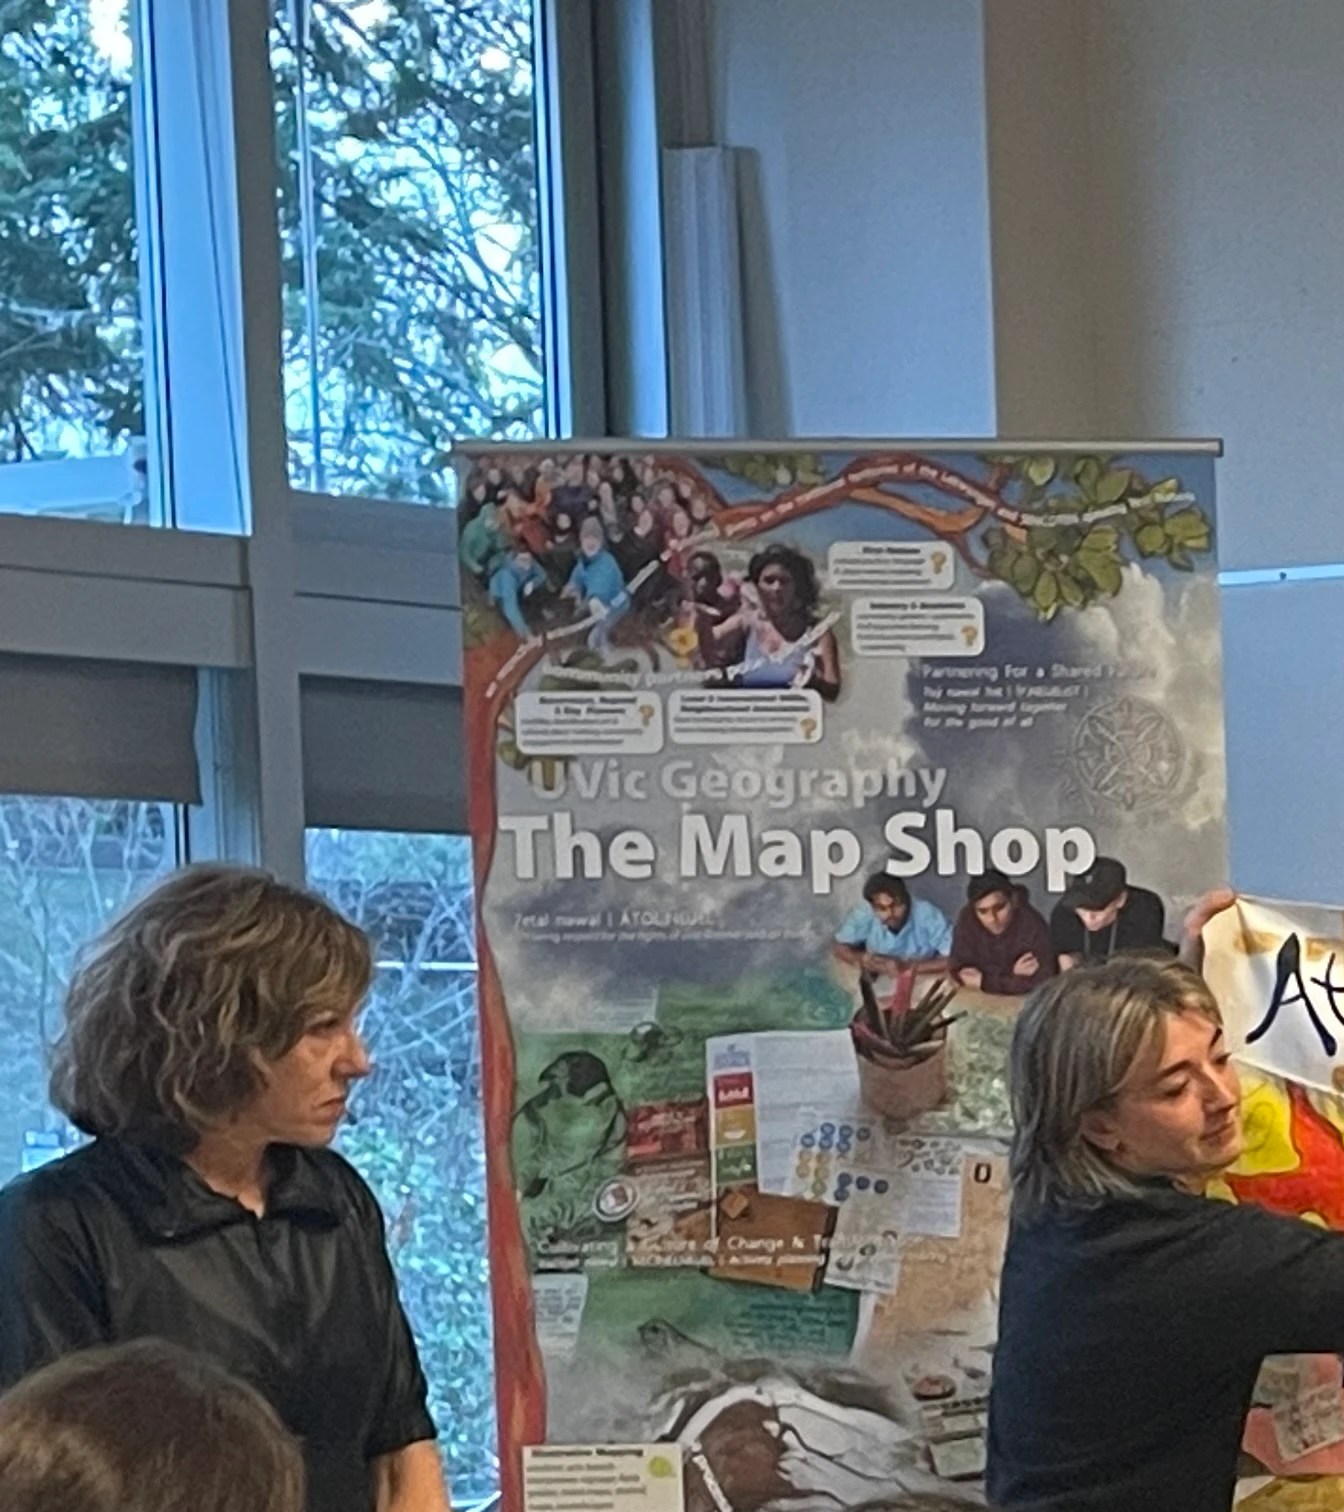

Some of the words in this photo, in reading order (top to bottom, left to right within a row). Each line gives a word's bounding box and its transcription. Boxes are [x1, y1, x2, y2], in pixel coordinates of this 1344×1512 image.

[528, 758, 647, 801] UVic
[661, 757, 948, 809] Geography
[499, 812, 656, 880] The
[680, 813, 862, 894] Map
[884, 809, 1096, 892] Shop
